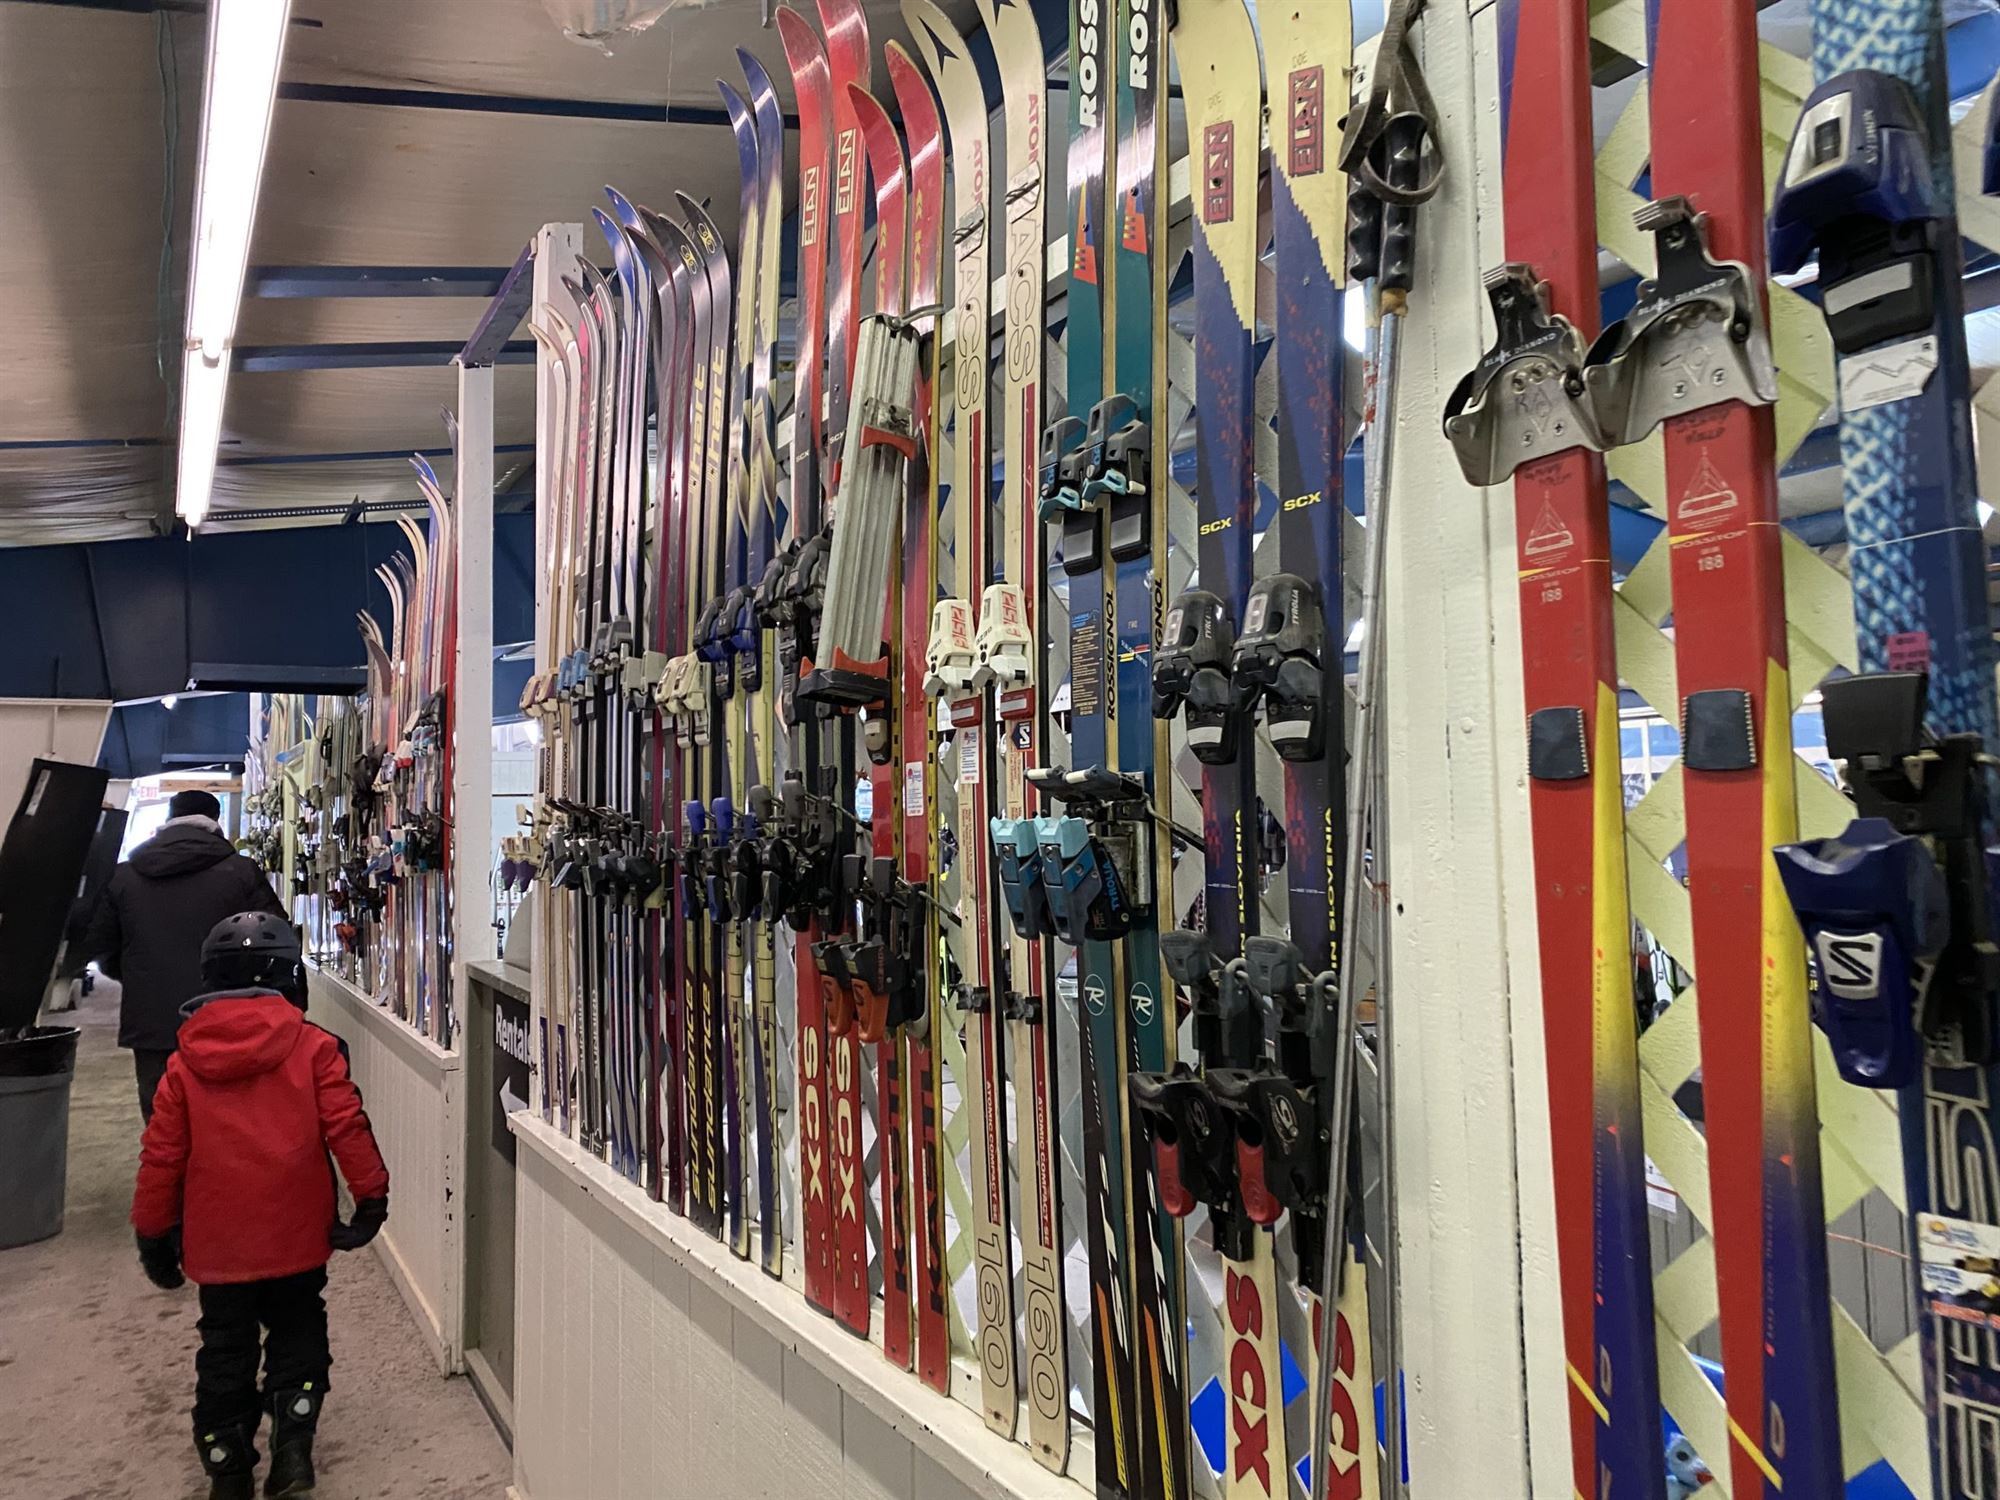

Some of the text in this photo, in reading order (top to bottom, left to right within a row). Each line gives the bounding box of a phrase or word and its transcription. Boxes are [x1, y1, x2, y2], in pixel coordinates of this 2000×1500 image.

[1291, 70, 1320, 172] ELAN
[803, 166, 818, 247] ELAN
[838, 128, 853, 215] ELAN
[690, 362, 705, 476] hart
[708, 345, 725, 464] hart
[796, 449, 810, 463] SCX
[1199, 517, 1233, 536] SCX
[1283, 491, 1322, 512] SCX
[1541, 588, 1563, 604] 188
[1697, 554, 1724, 572] 188
[1290, 588, 1300, 626] TYROLIA
[1106, 590, 1115, 721] ROSSIGNOL
[140, 786, 158, 798] EXIT
[1102, 859, 1120, 911] TYROLIA
[1234, 808, 1245, 924] SLOVENIA
[1325, 807, 1336, 932] SLOVENIA
[685, 978, 700, 1204] sundance
[702, 981, 716, 1214] sundance
[803, 1026, 823, 1205] SCX
[835, 1036, 857, 1224] SCX
[986, 1079, 994, 1132] ATOMIC
[1037, 1096, 1046, 1150] ATOMIC
[988, 1133, 998, 1201] COMPACT
[1040, 1151, 1049, 1220] COMPACT
[977, 1233, 1009, 1388] 160
[1026, 1256, 1061, 1420] 160
[1225, 1269, 1271, 1499] SCX
